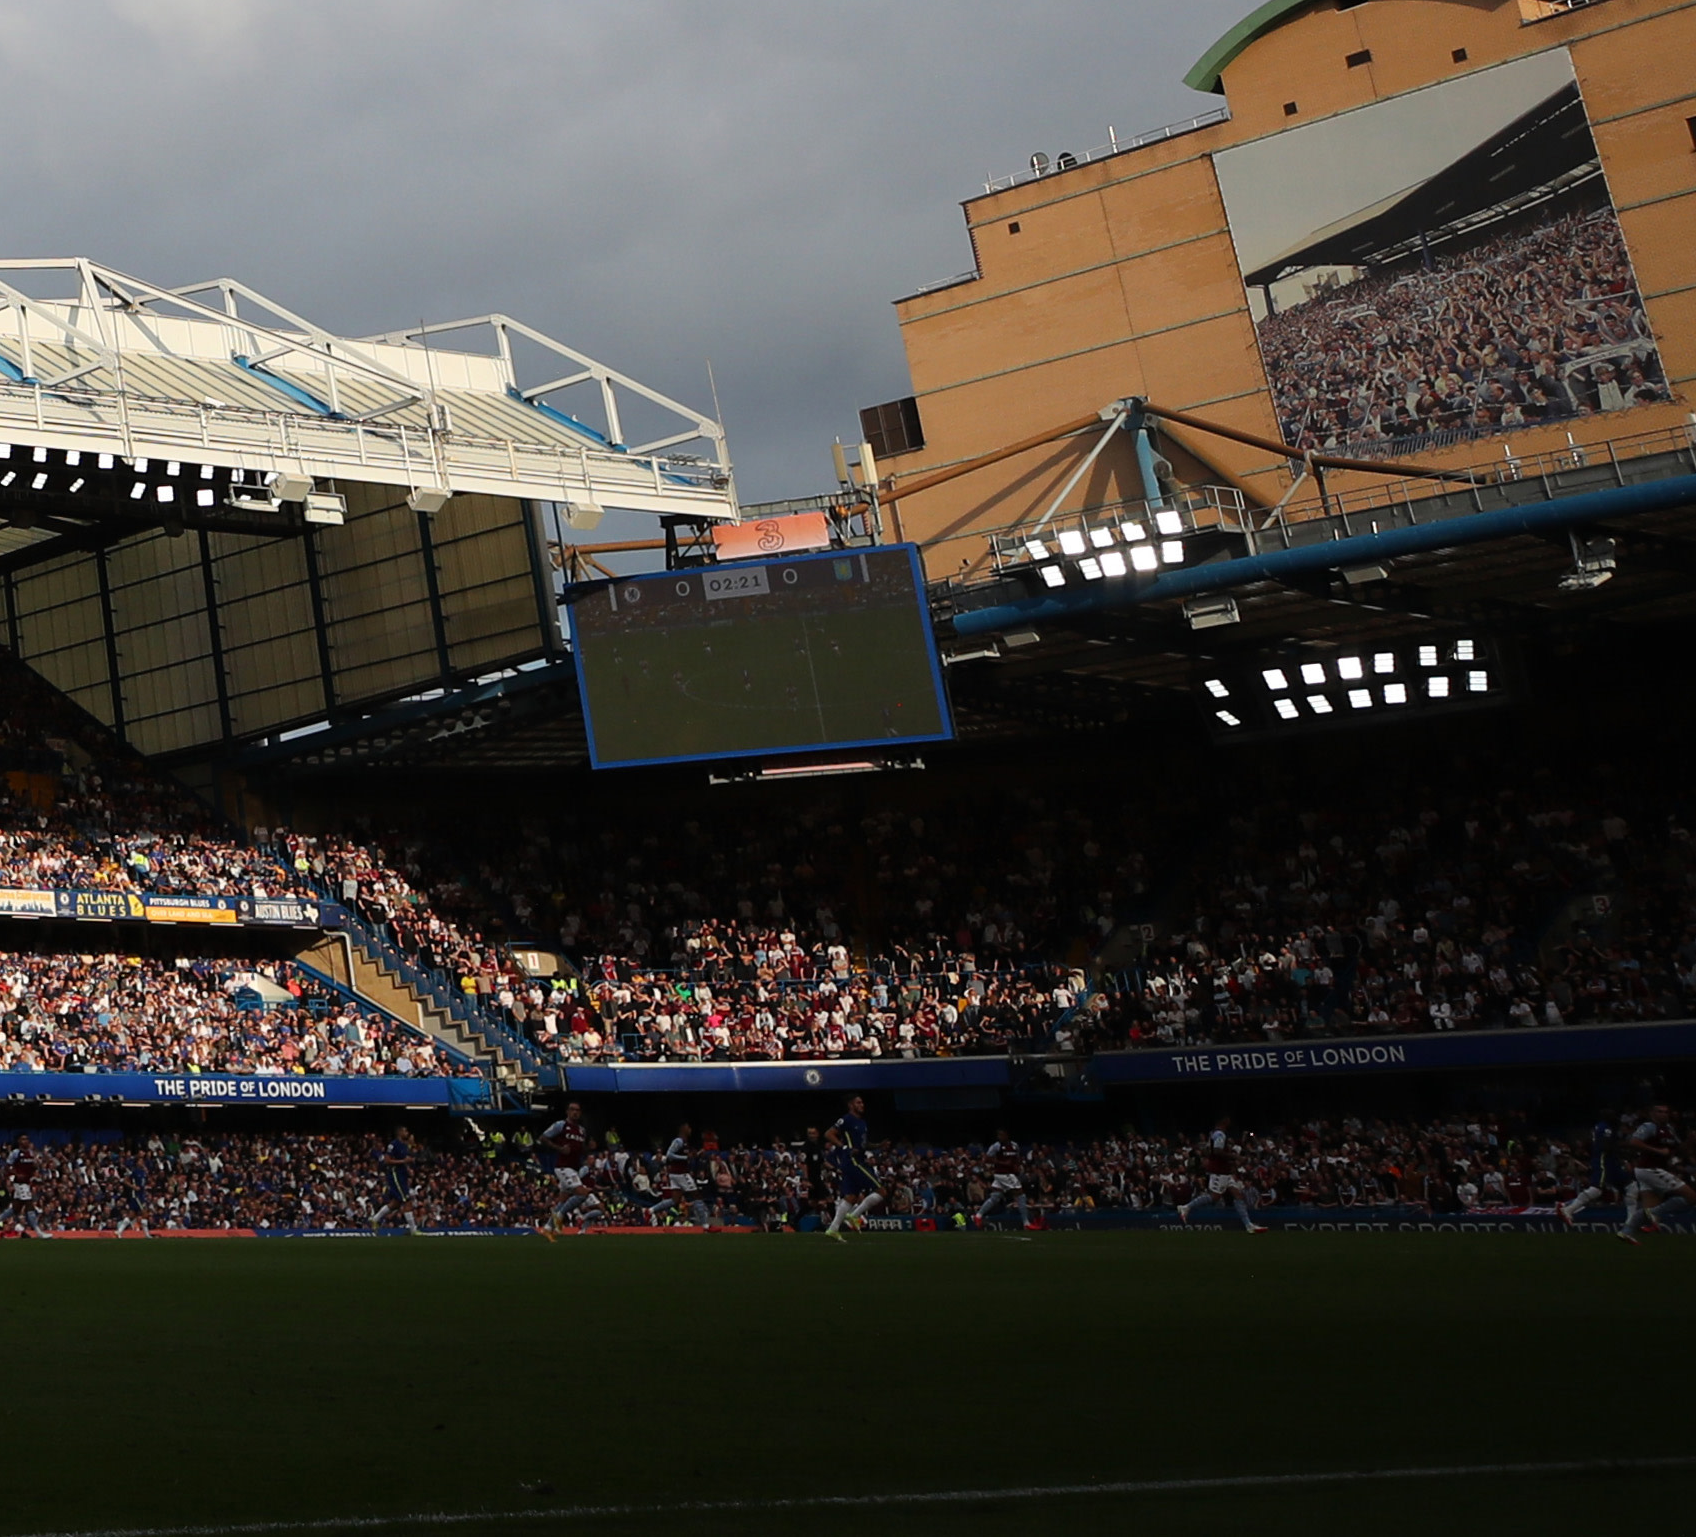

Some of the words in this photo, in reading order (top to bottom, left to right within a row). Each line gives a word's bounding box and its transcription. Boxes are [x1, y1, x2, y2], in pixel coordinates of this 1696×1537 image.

[710, 574, 762, 593] 02:21
[76, 892, 125, 905] ATLANTA
[149, 897, 188, 906] PITTSBURGH
[190, 899, 210, 908] BLUES
[76, 905, 127, 916] BLUES
[255, 903, 281, 919] AUSTIN
[282, 905, 304, 920] BLUES
[1142, 927, 1152, 939] 2
[1172, 1055, 1211, 1072] THE
[1216, 1052, 1279, 1070] PRIDE
[1284, 1051, 1306, 1068] OF
[1310, 1045, 1405, 1066] LONDON
[155, 1080, 185, 1095] THE
[190, 1081, 237, 1096] PRIDE
[241, 1082, 256, 1097] OF
[259, 1082, 324, 1097] LONDON
